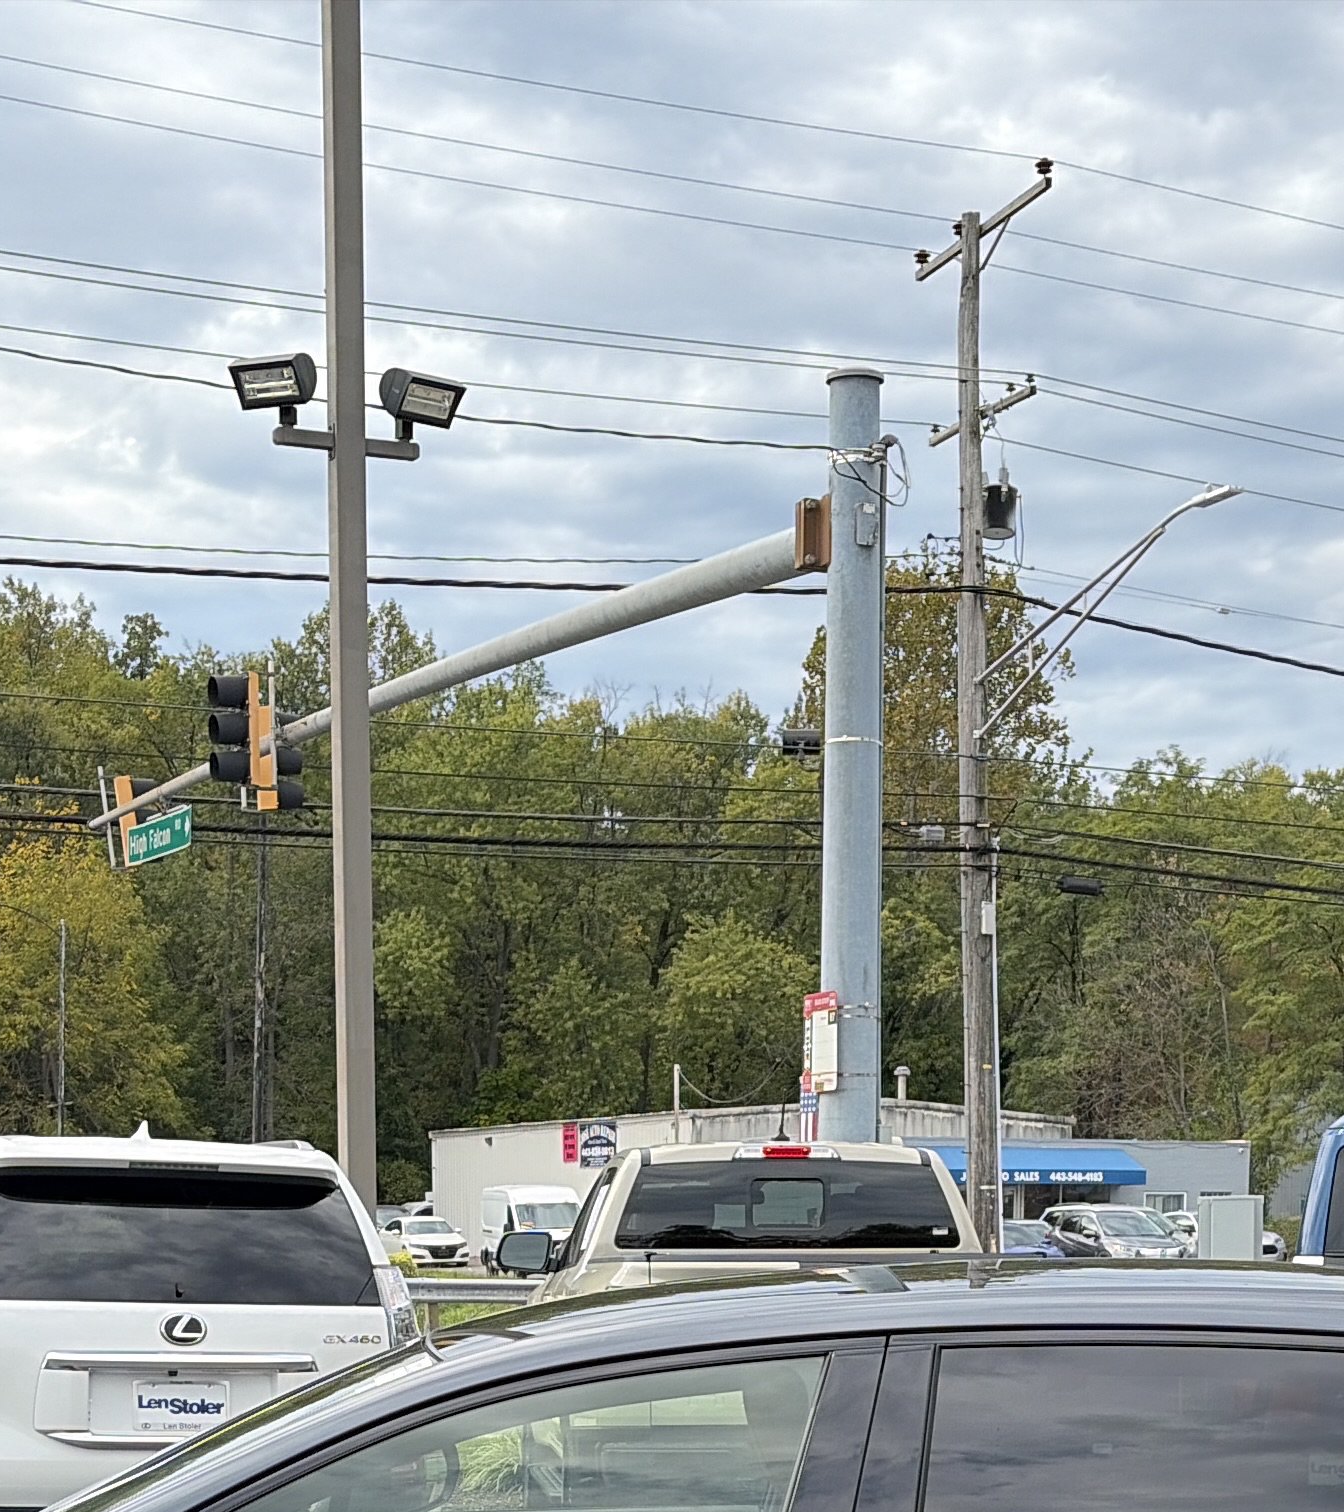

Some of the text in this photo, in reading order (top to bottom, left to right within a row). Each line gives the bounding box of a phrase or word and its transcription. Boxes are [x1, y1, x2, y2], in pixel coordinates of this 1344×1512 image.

[129, 833, 147, 860] High
[149, 827, 171, 850] Falcon
[1014, 1171, 1040, 1181] SALES
